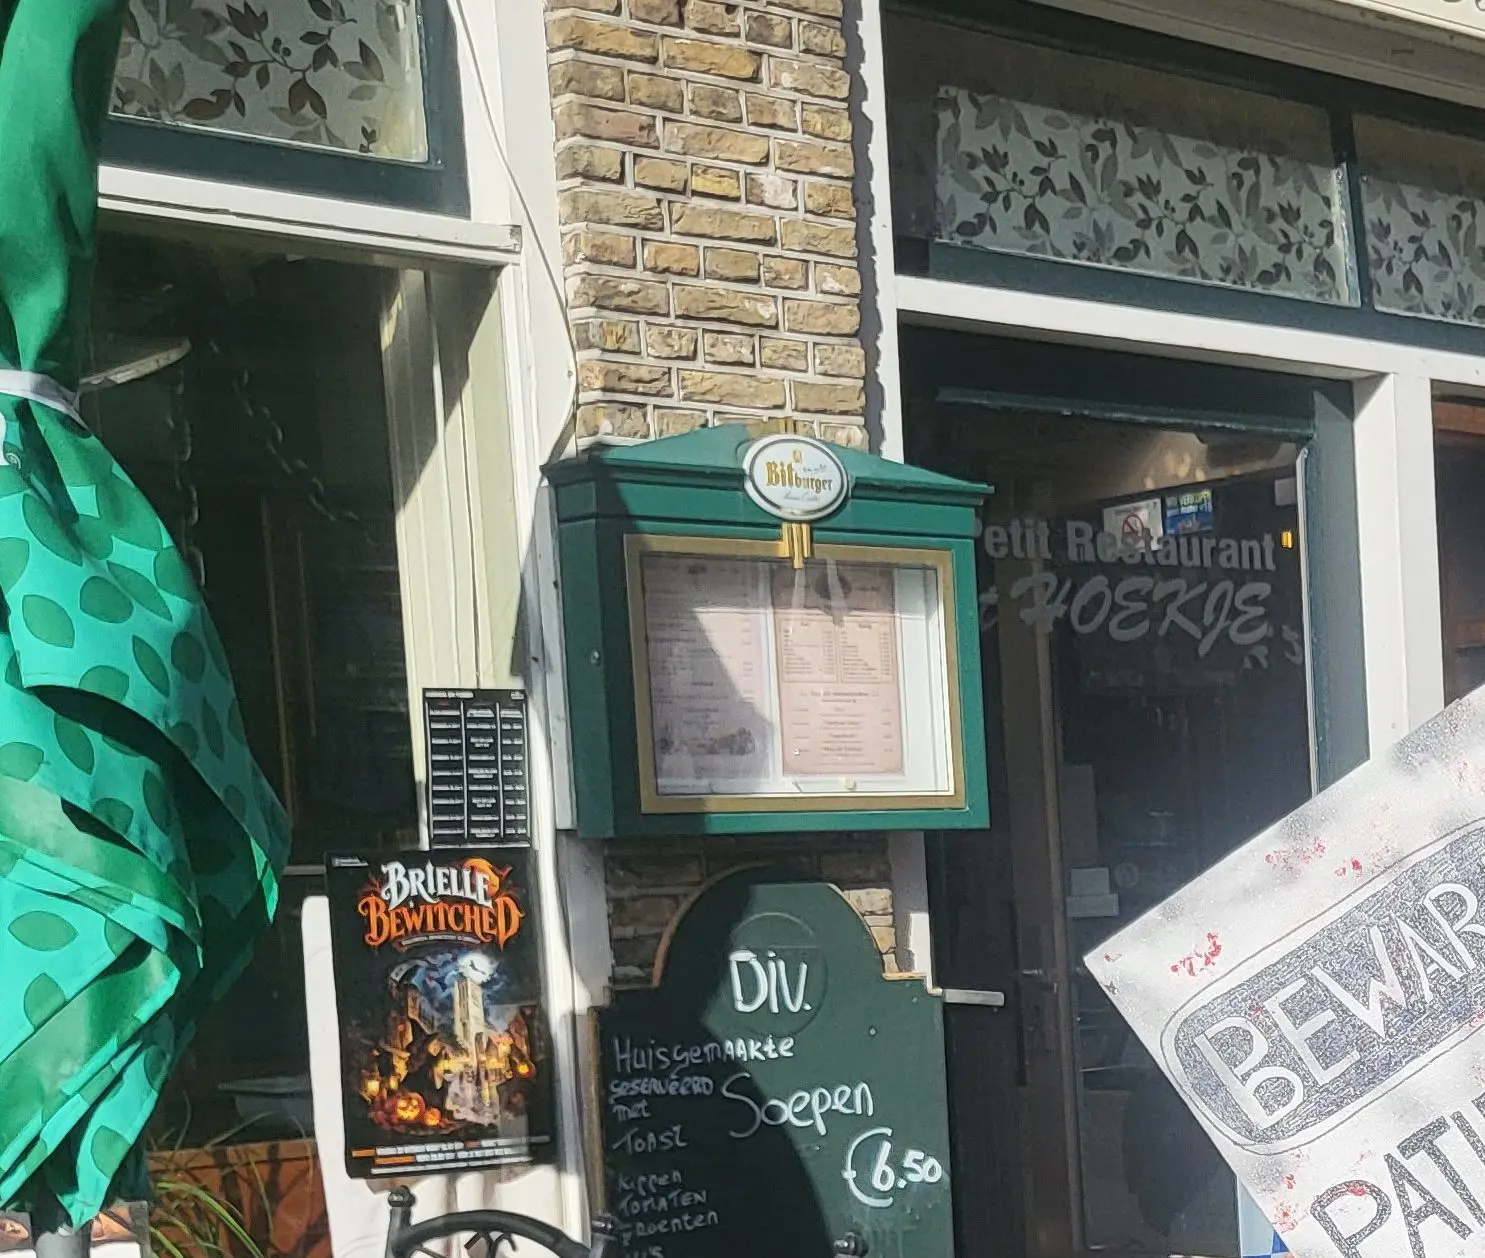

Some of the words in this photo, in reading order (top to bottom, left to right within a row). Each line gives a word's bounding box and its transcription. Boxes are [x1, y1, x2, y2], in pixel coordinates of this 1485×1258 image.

[766, 460, 833, 494] Bitburger
[1066, 520, 1276, 572] Restaurant
[1010, 572, 1273, 657] HOEKJE
[380, 861, 494, 908] BRIELLE
[358, 894, 526, 949] BEWITCHED
[721, 1072, 875, 1138] Soepen
